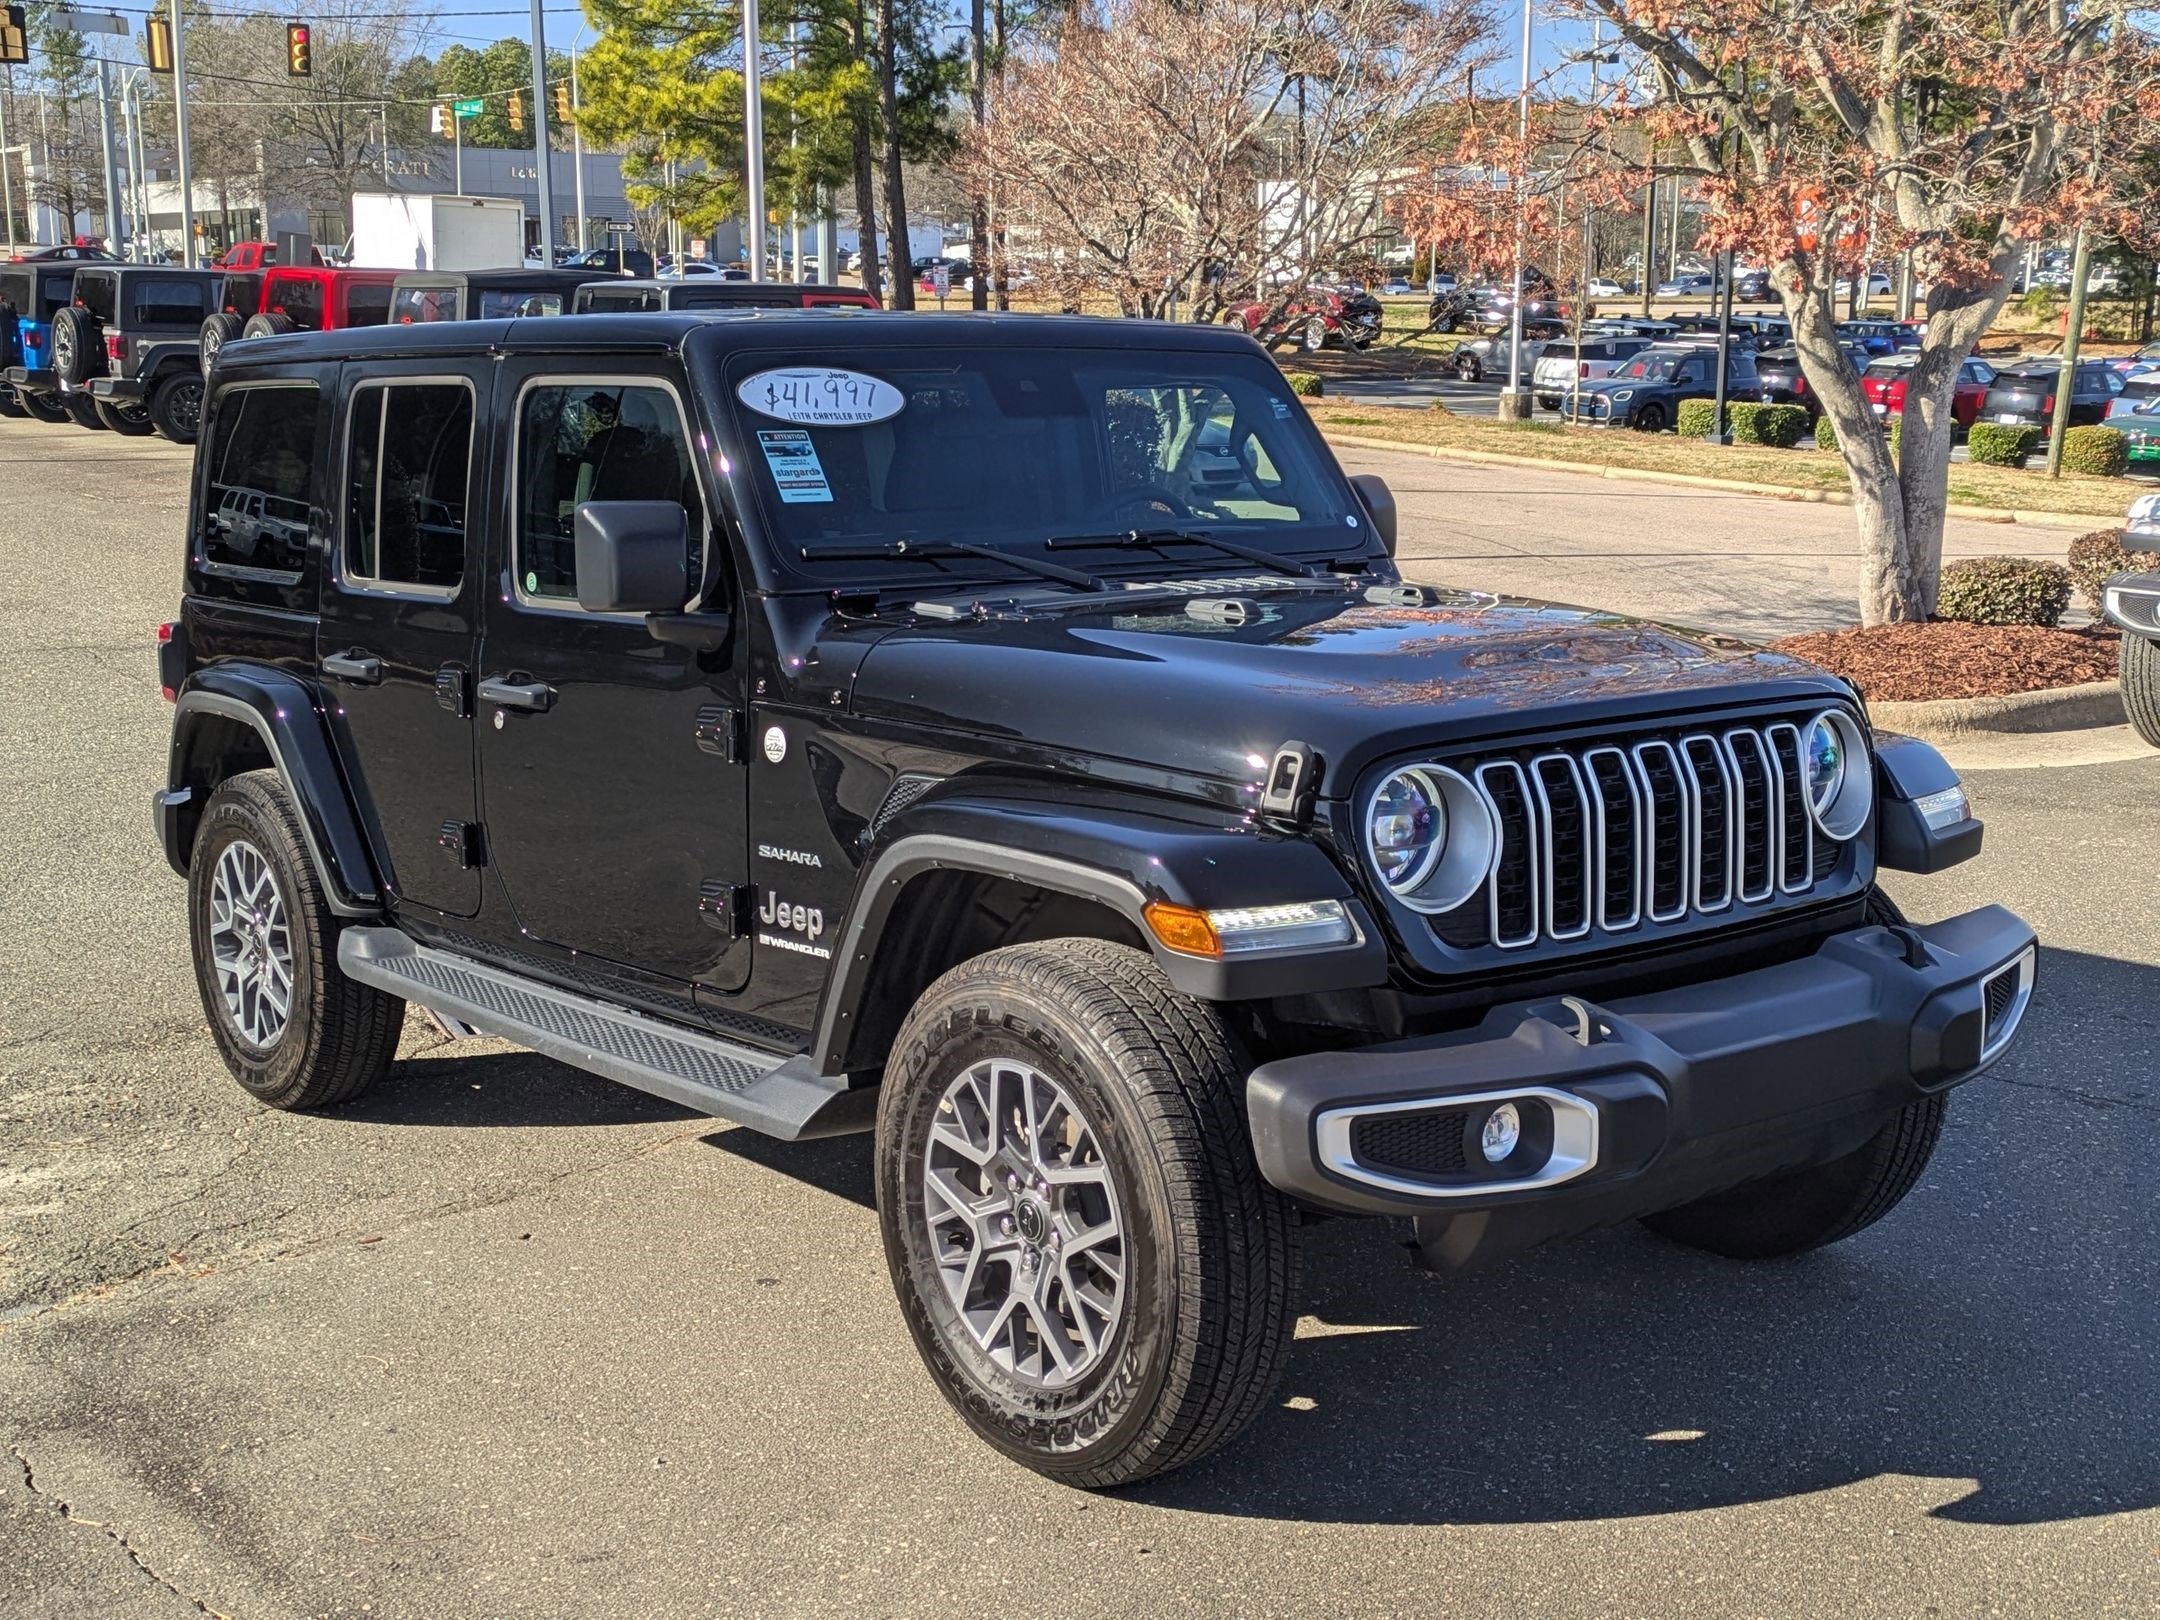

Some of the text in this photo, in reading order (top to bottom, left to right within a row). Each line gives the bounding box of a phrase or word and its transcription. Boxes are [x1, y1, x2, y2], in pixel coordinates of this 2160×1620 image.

[828, 372, 849, 380] Jeep
[765, 380, 877, 412] $41,997
[788, 412, 873, 421] LEITH CHRYSLER JEEP
[774, 433, 806, 441] ATTENTION
[758, 845, 822, 868] SAHARA
[759, 891, 824, 941] Jeep
[769, 937, 830, 960] WRANGLER
[905, 1005, 1061, 1090] DUELER
[932, 1348, 1139, 1447] BRIDGESTONE
